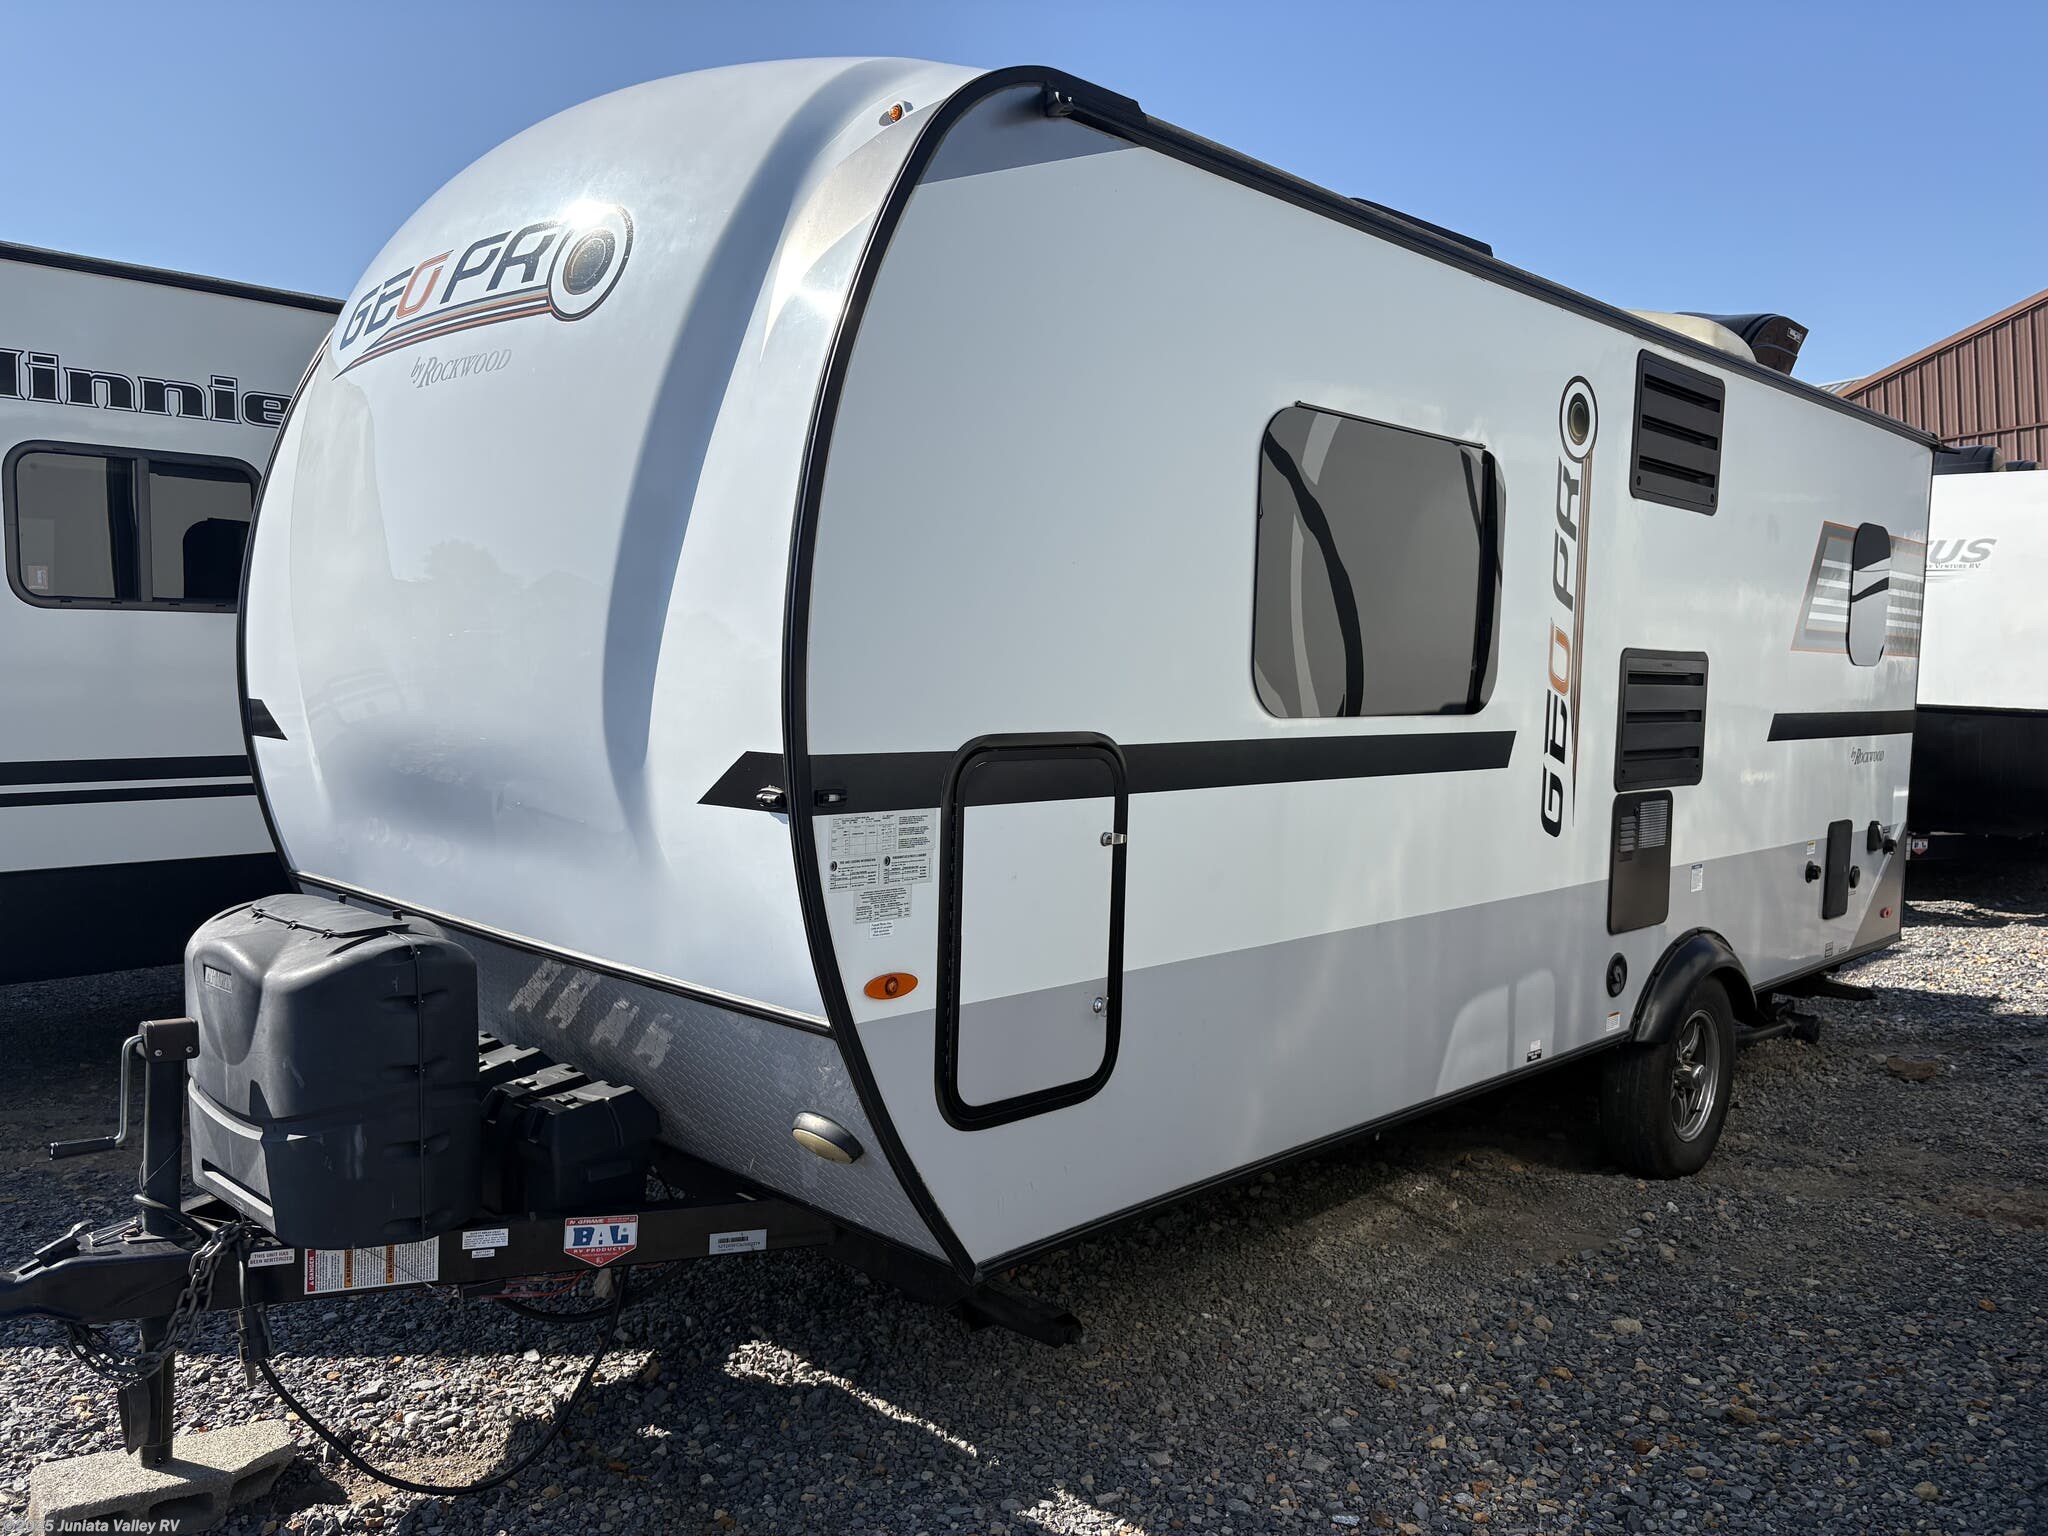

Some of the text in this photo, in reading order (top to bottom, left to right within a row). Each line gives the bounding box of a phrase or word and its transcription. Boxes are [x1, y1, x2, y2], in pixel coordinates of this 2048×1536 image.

[339, 205, 634, 351] GEO PRO
[409, 356, 424, 385] by
[1928, 538, 1998, 563] US
[1541, 375, 1598, 838] GEO PRO
[572, 1225, 630, 1247] BAL
